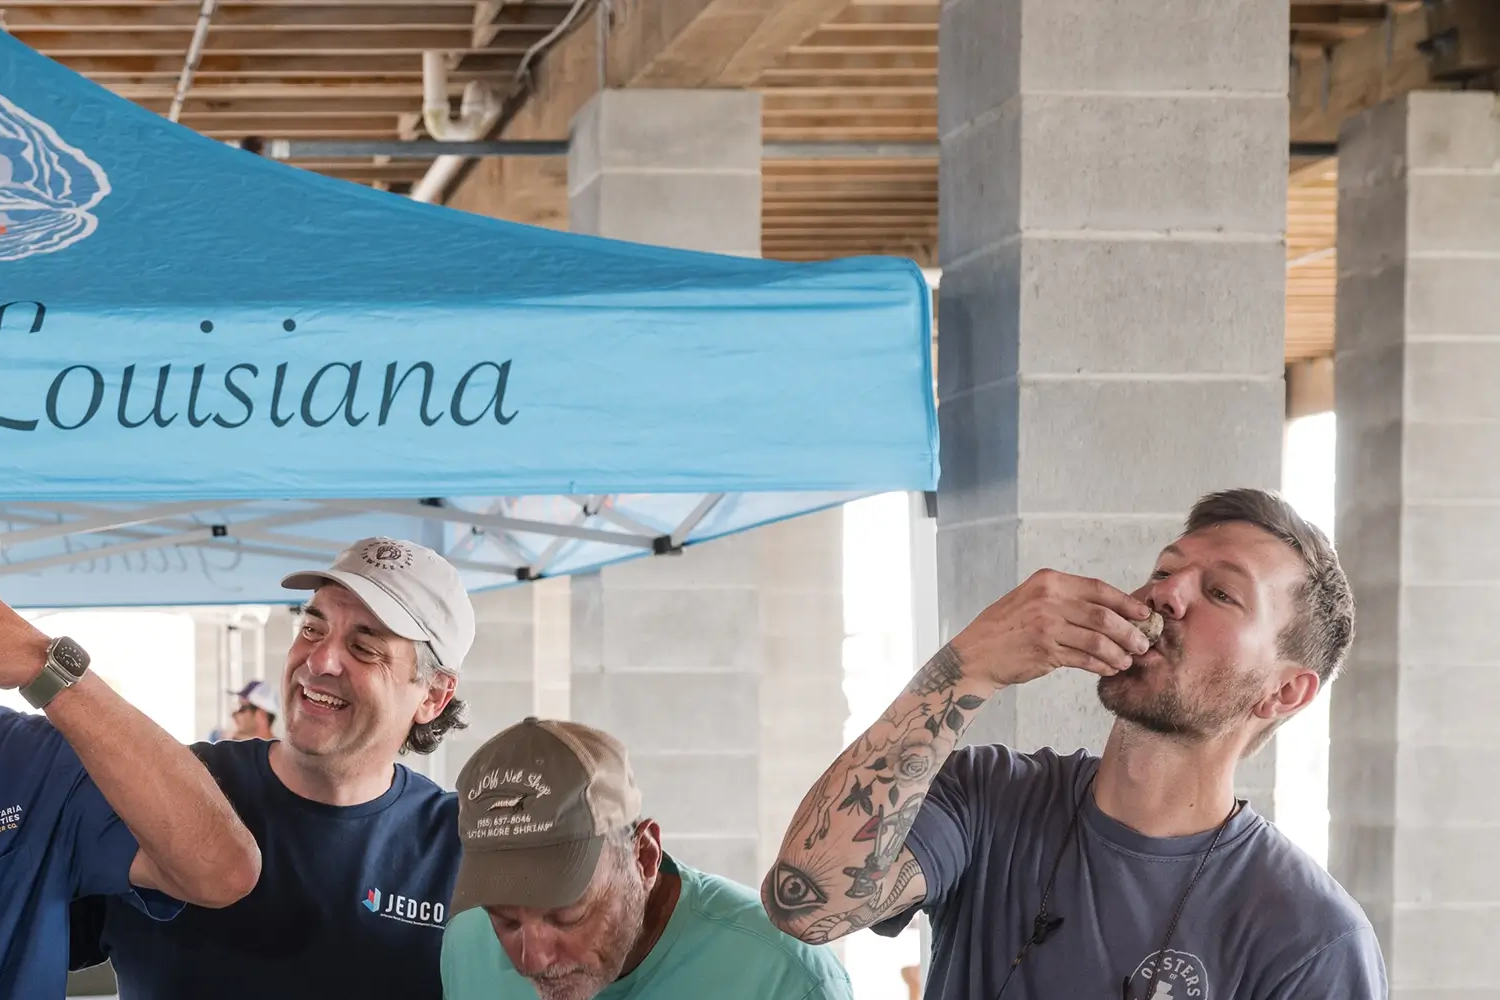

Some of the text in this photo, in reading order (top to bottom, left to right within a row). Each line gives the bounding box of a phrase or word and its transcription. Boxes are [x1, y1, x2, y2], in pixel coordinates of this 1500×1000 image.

[482, 767, 499, 790] Off
[500, 768, 523, 785] Net
[524, 772, 552, 799] Shop
[487, 827, 510, 837] MORE
[385, 894, 445, 923] JEDCO
